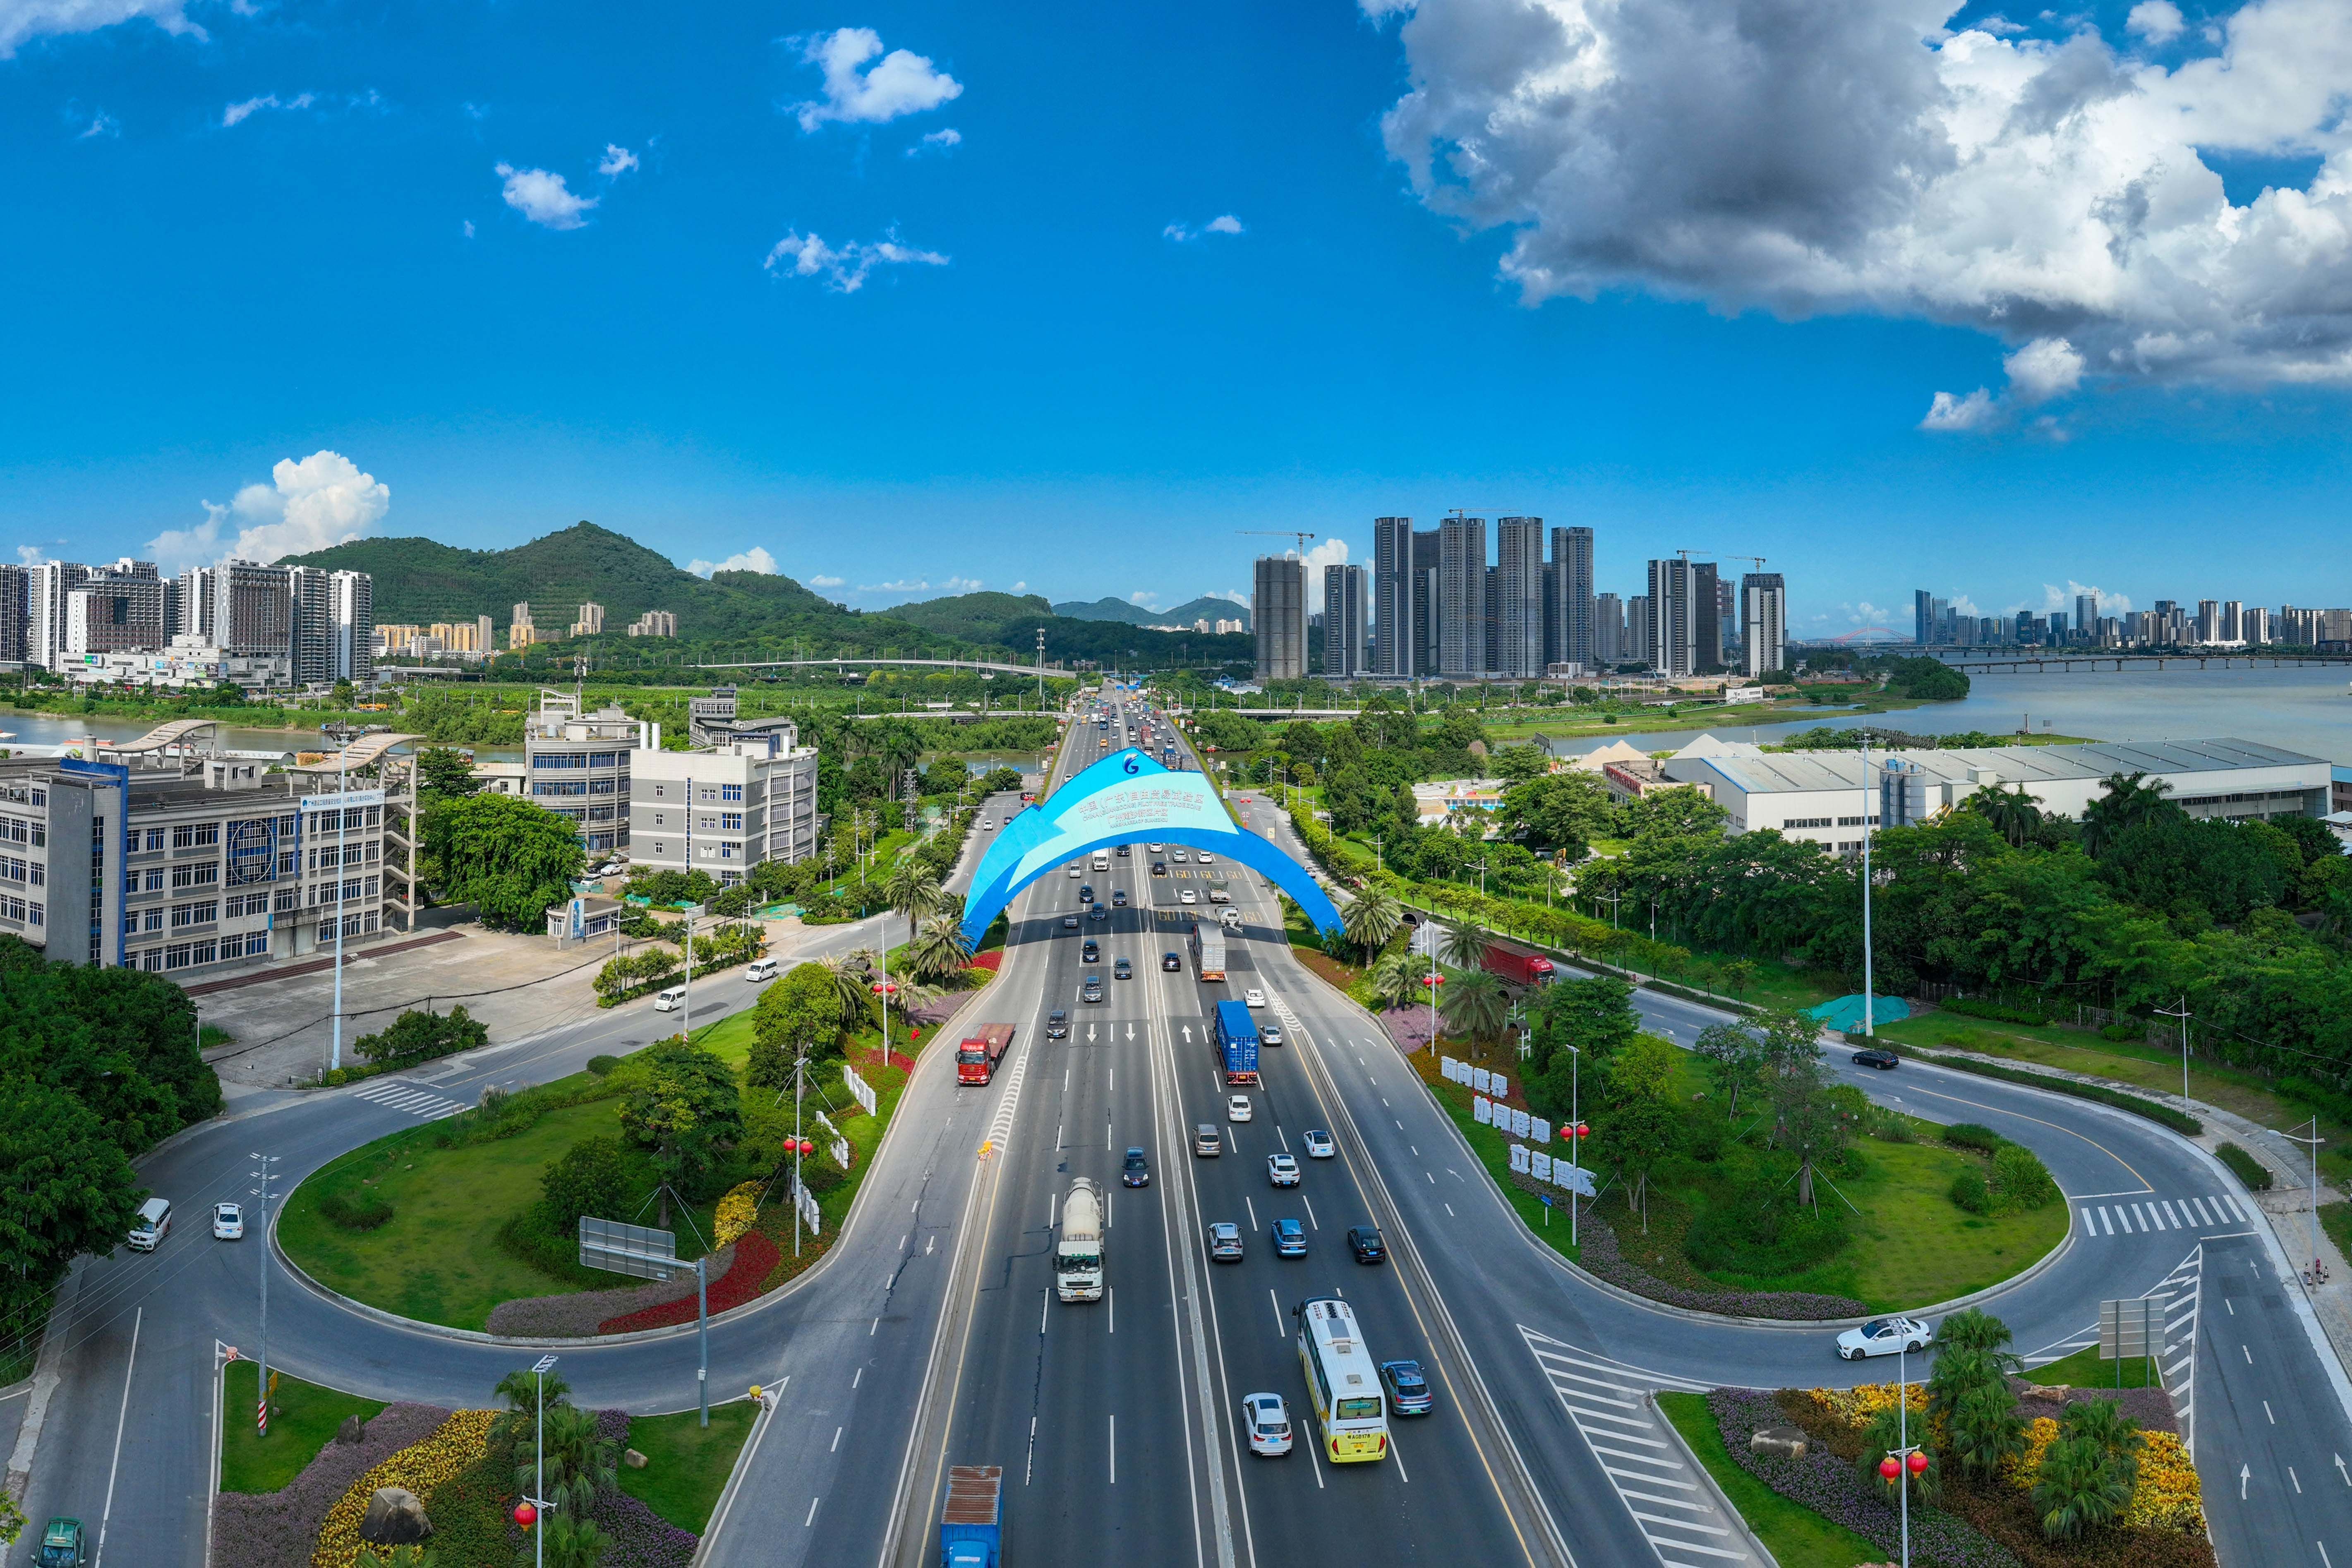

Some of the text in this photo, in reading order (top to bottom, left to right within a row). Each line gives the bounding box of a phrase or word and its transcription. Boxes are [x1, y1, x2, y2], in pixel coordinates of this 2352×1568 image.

[1079, 789, 1204, 815] 中国（广东）自由贸易试验区
[1176, 870, 1192, 879] 60
[1200, 870, 1216, 879] 60
[1226, 871, 1242, 879] 60
[1159, 910, 1176, 921] 60
[1244, 911, 1262, 922] 60
[1441, 1056, 1508, 1099] 面向世界
[1474, 1096, 1551, 1144] 协同港澳
[1510, 1144, 1597, 1197] 立足湾区
